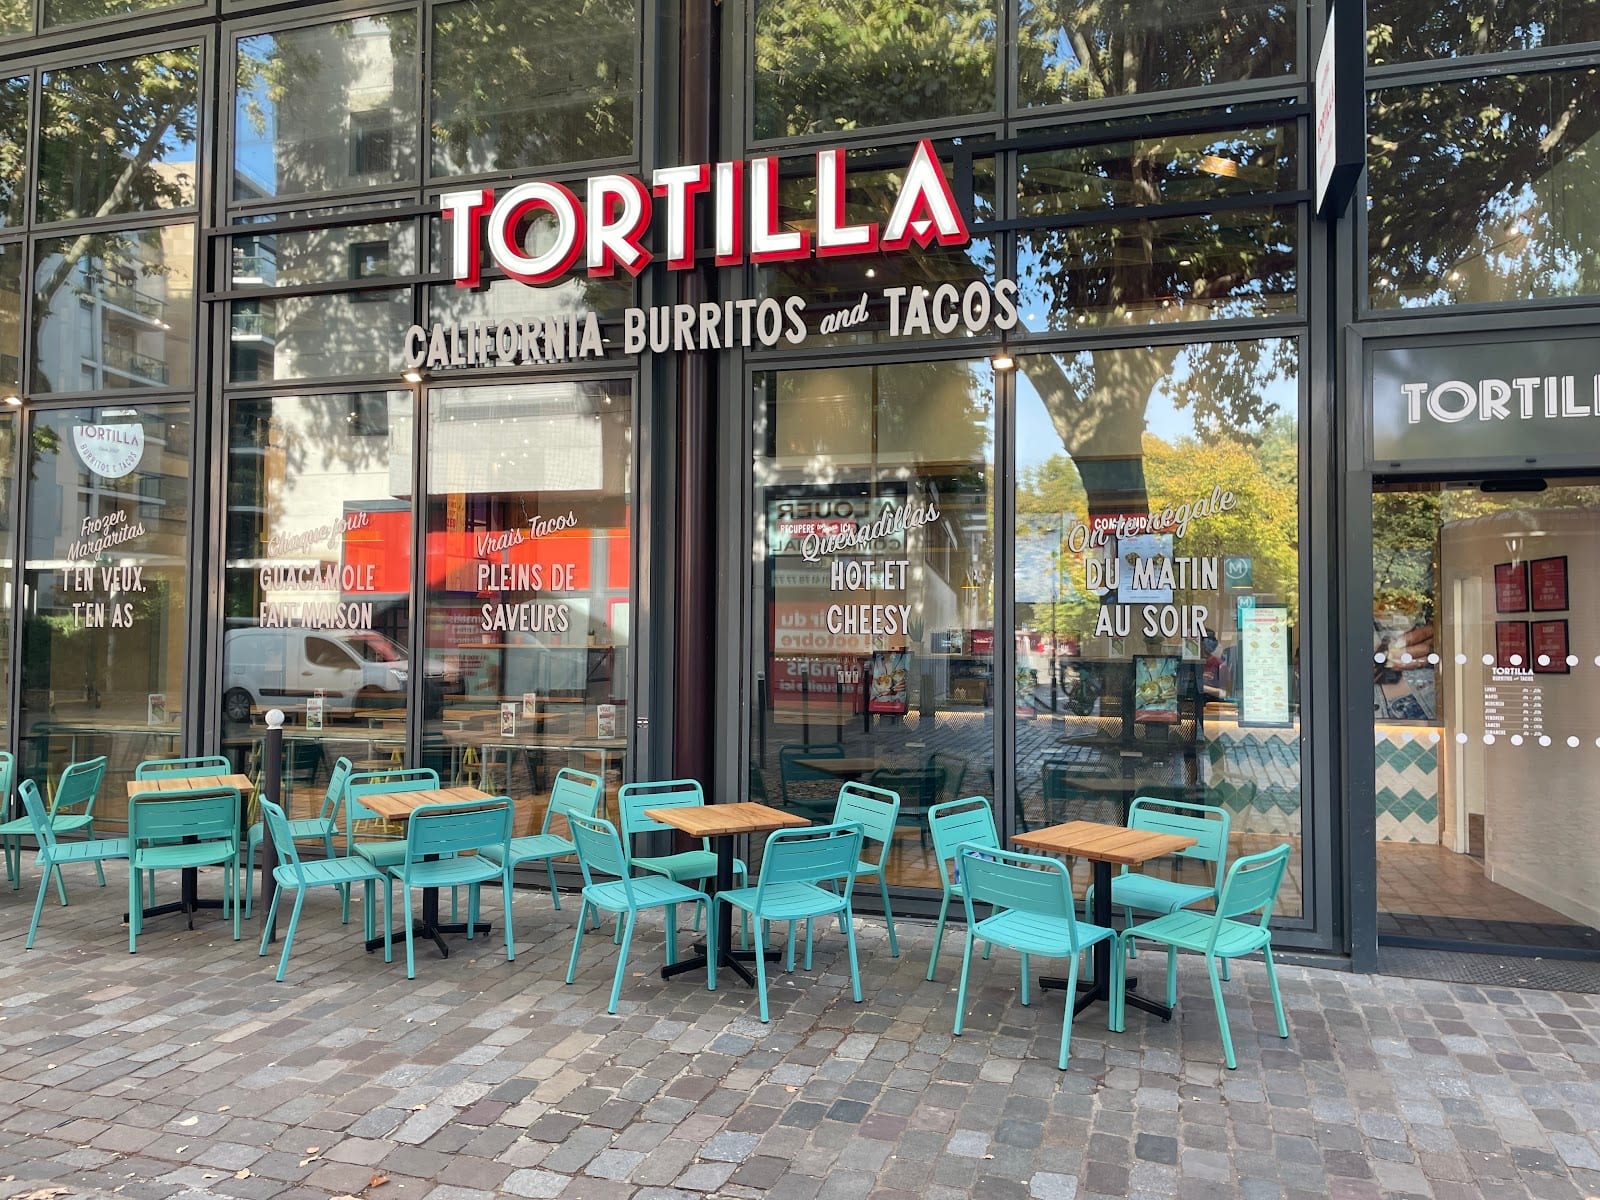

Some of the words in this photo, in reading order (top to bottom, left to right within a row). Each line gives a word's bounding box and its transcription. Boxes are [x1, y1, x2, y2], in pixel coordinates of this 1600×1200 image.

[440, 138, 970, 288] TORTILLA
[404, 311, 604, 368] CALIFORNIA
[624, 295, 808, 354] BURRITOS
[820, 292, 869, 335] and
[883, 278, 1020, 337] TACOS
[1401, 374, 1600, 424] TORTIL
[80, 424, 139, 447] TORTILLA
[81, 509, 127, 537] Frozen
[327, 511, 369, 549] jour
[477, 528, 524, 556] Vrais
[528, 510, 578, 540] Tacos
[801, 502, 940, 562] Quesadillas
[1068, 524, 1108, 553] On
[1115, 513, 1139, 539] te
[1147, 485, 1237, 538] régale
[67, 522, 146, 561] Margaritas
[101, 566, 147, 592] VEUX,
[259, 564, 376, 592] GUACAMOLE
[477, 563, 543, 591] PLEINS
[551, 563, 576, 591] DE
[830, 560, 876, 591] HOT
[884, 560, 909, 590] ET
[1086, 557, 1120, 590] DU
[1132, 557, 1218, 590] MATIN
[72, 601, 105, 628] T'EN
[111, 602, 134, 628] AS
[259, 602, 297, 628] FAIT
[301, 602, 373, 629] MAISON
[481, 603, 569, 632] SAVEURS
[827, 604, 912, 635] CHEESY
[1094, 604, 1131, 637] AU
[1142, 604, 1208, 638] SOIR
[1492, 667, 1534, 675] TORTILLA
